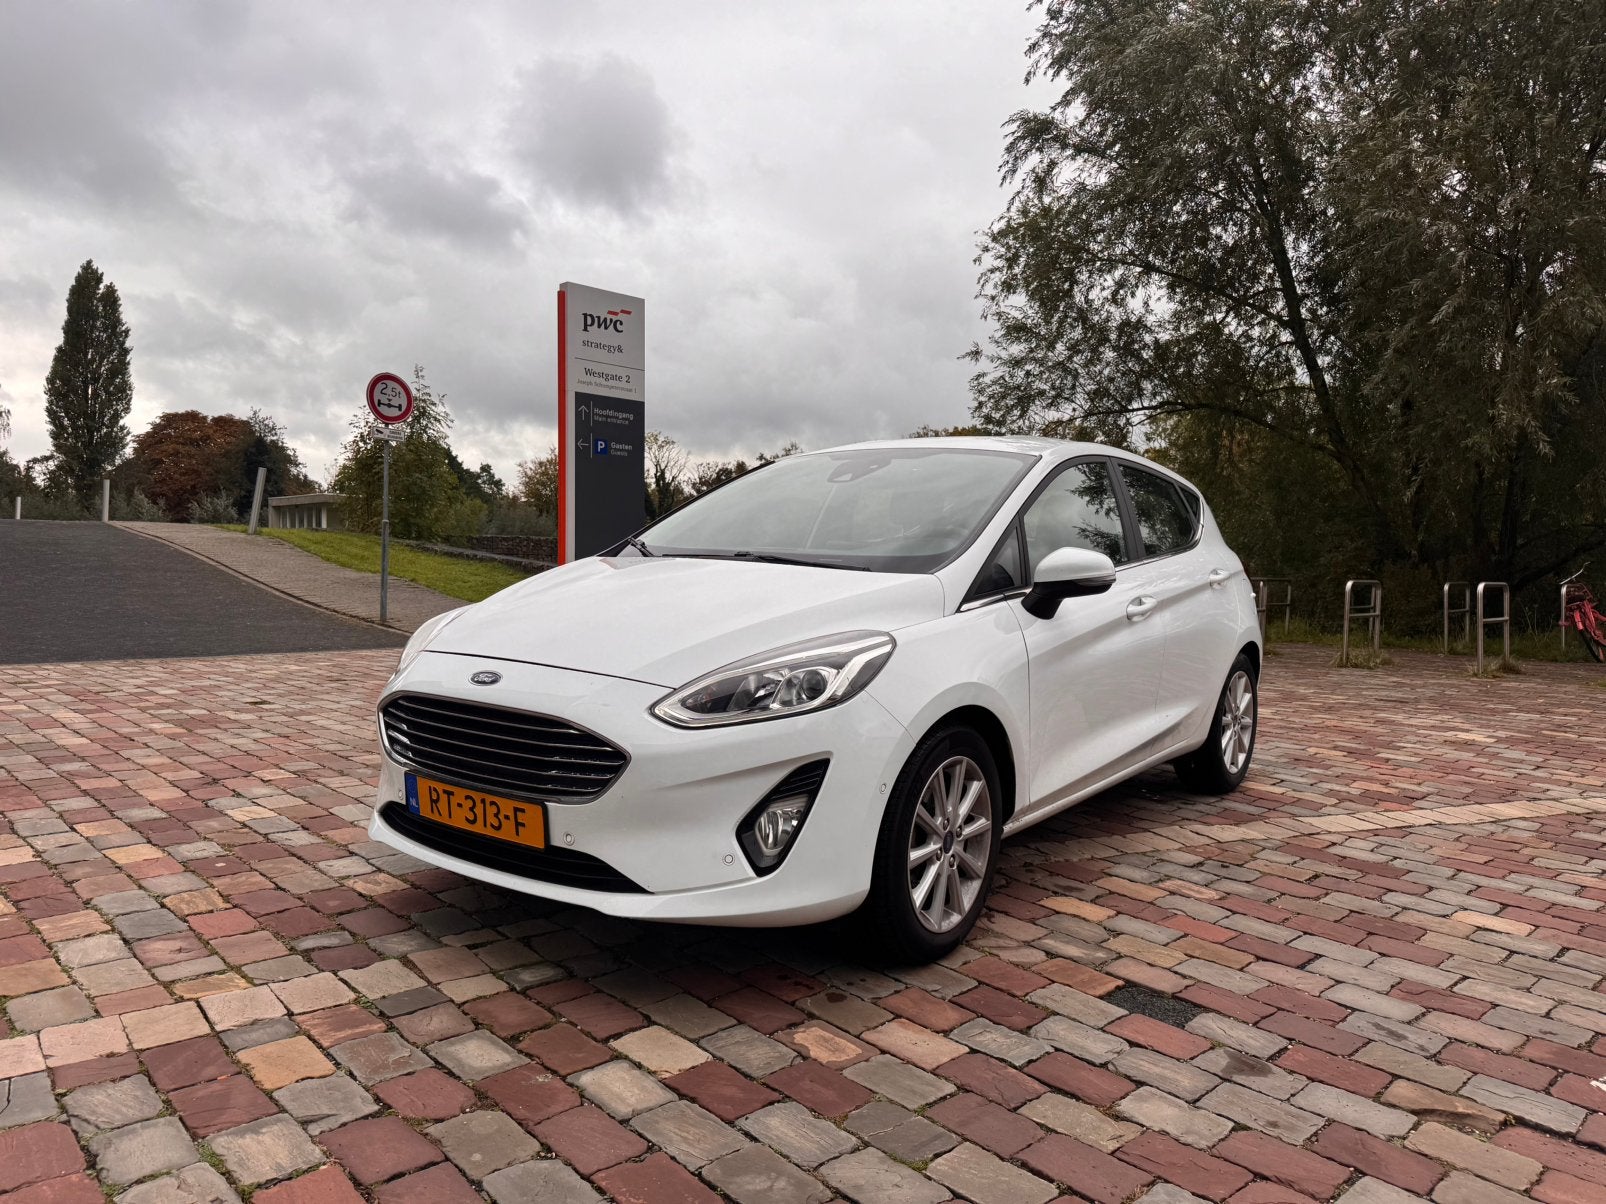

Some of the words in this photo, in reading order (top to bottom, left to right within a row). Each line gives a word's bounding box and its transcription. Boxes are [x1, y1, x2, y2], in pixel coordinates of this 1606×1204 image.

[582, 312, 624, 333] pwc
[582, 339, 624, 354] strategy&
[584, 367, 623, 382] Westgate
[625, 374, 631, 384] 2
[593, 407, 634, 421] Hoofdingang
[597, 440, 605, 453] P
[610, 441, 633, 451] Gasten
[410, 797, 419, 807] NL
[428, 785, 526, 837] RT-313-F
